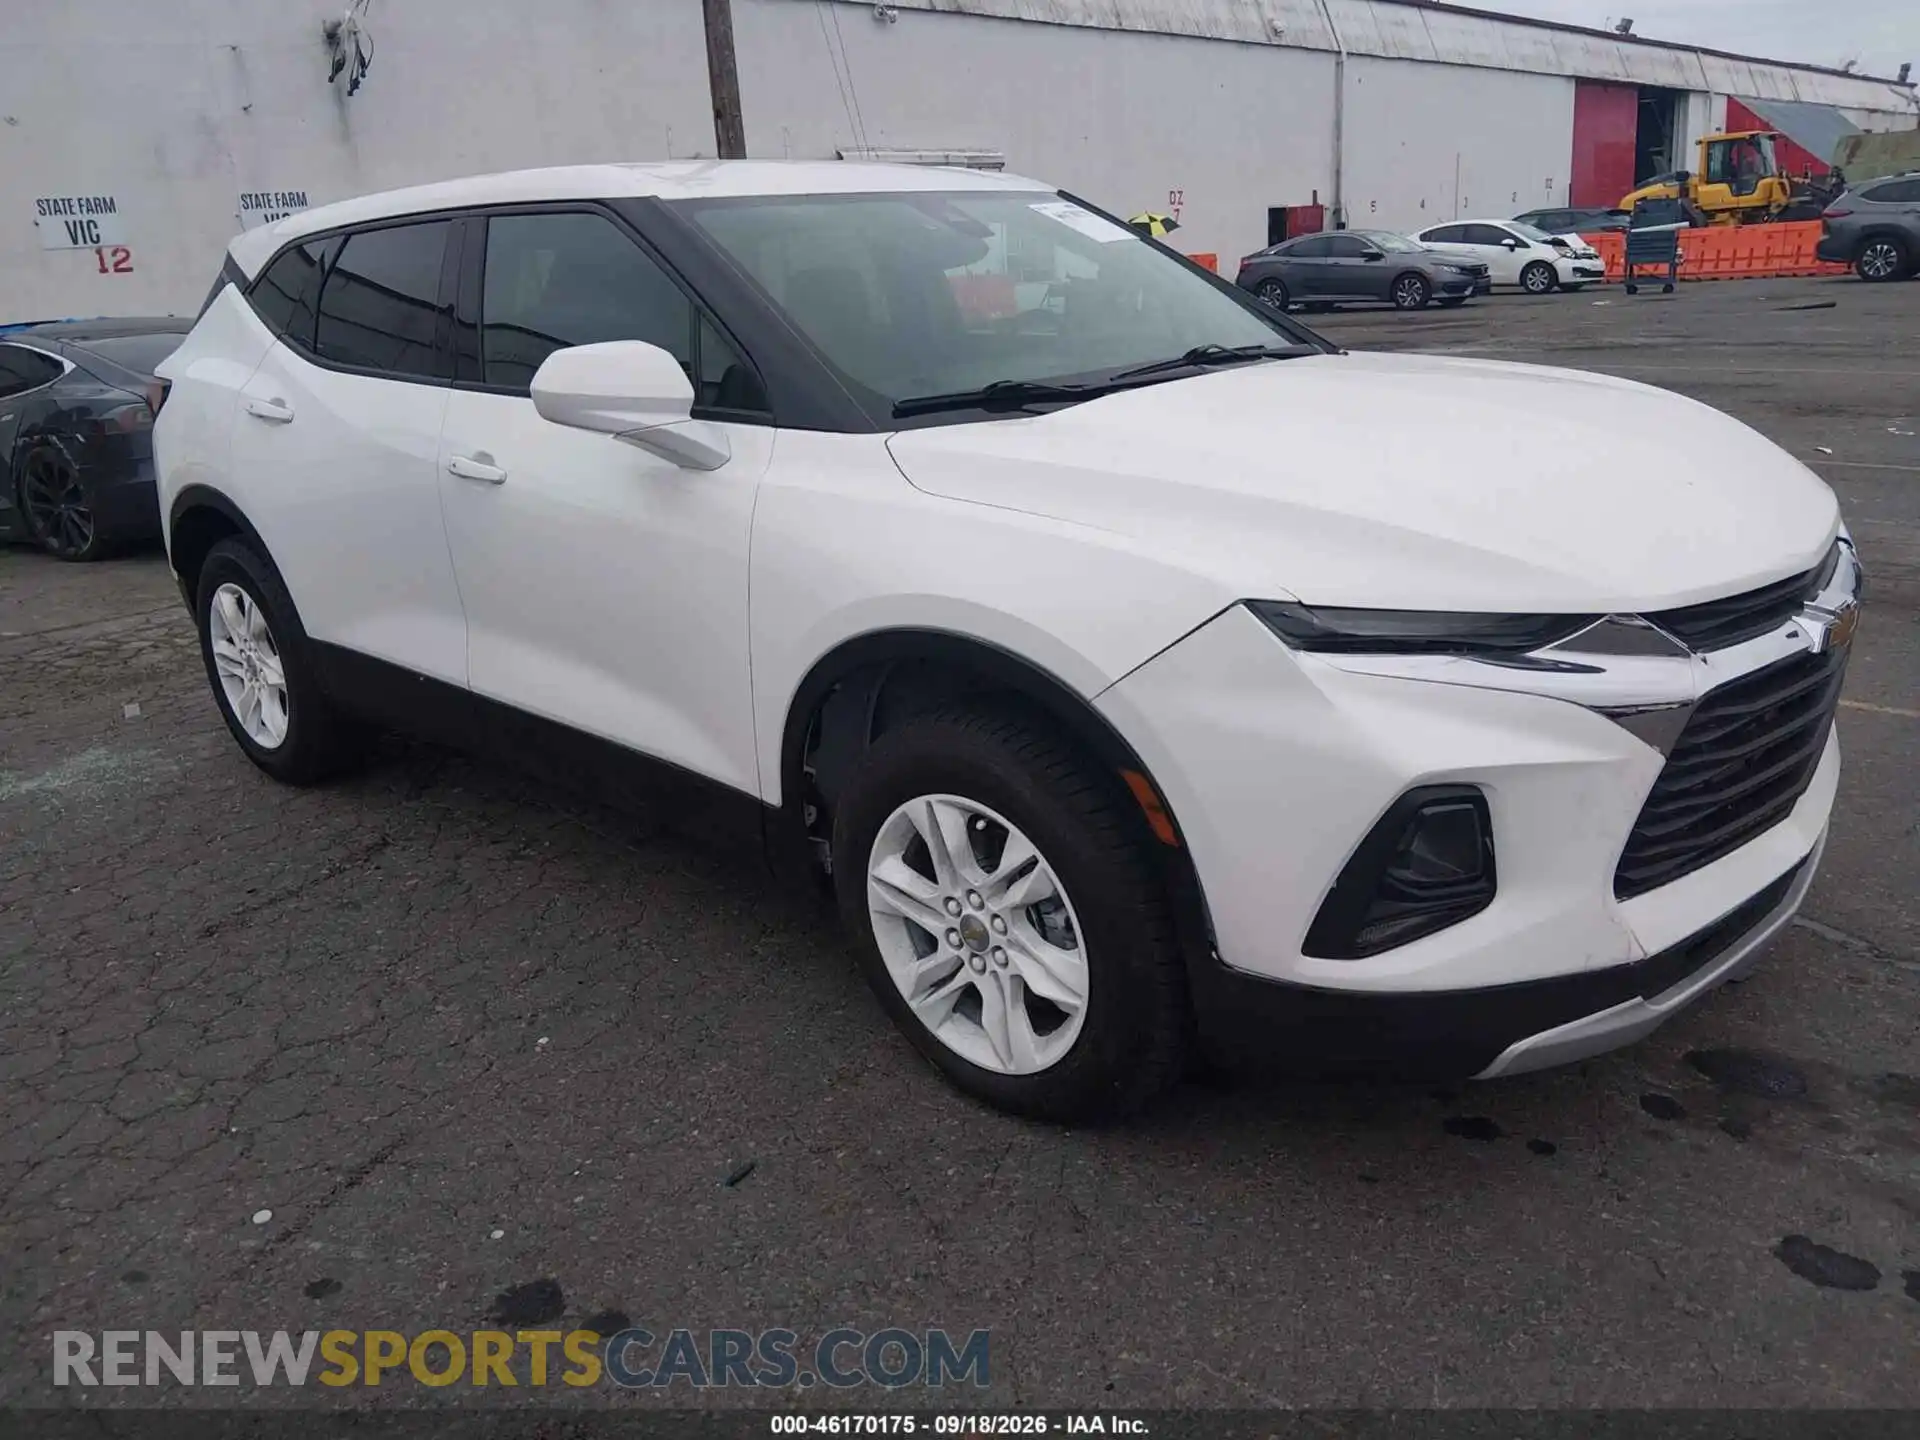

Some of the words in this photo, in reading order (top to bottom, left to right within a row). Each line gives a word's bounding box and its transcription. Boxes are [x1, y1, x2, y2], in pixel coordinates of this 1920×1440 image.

[36, 198, 76, 216] STATE
[77, 197, 117, 215] FARM
[241, 193, 274, 210] STATE
[274, 191, 308, 208] FARM
[64, 219, 101, 245] VIC
[95, 247, 134, 273] 12
